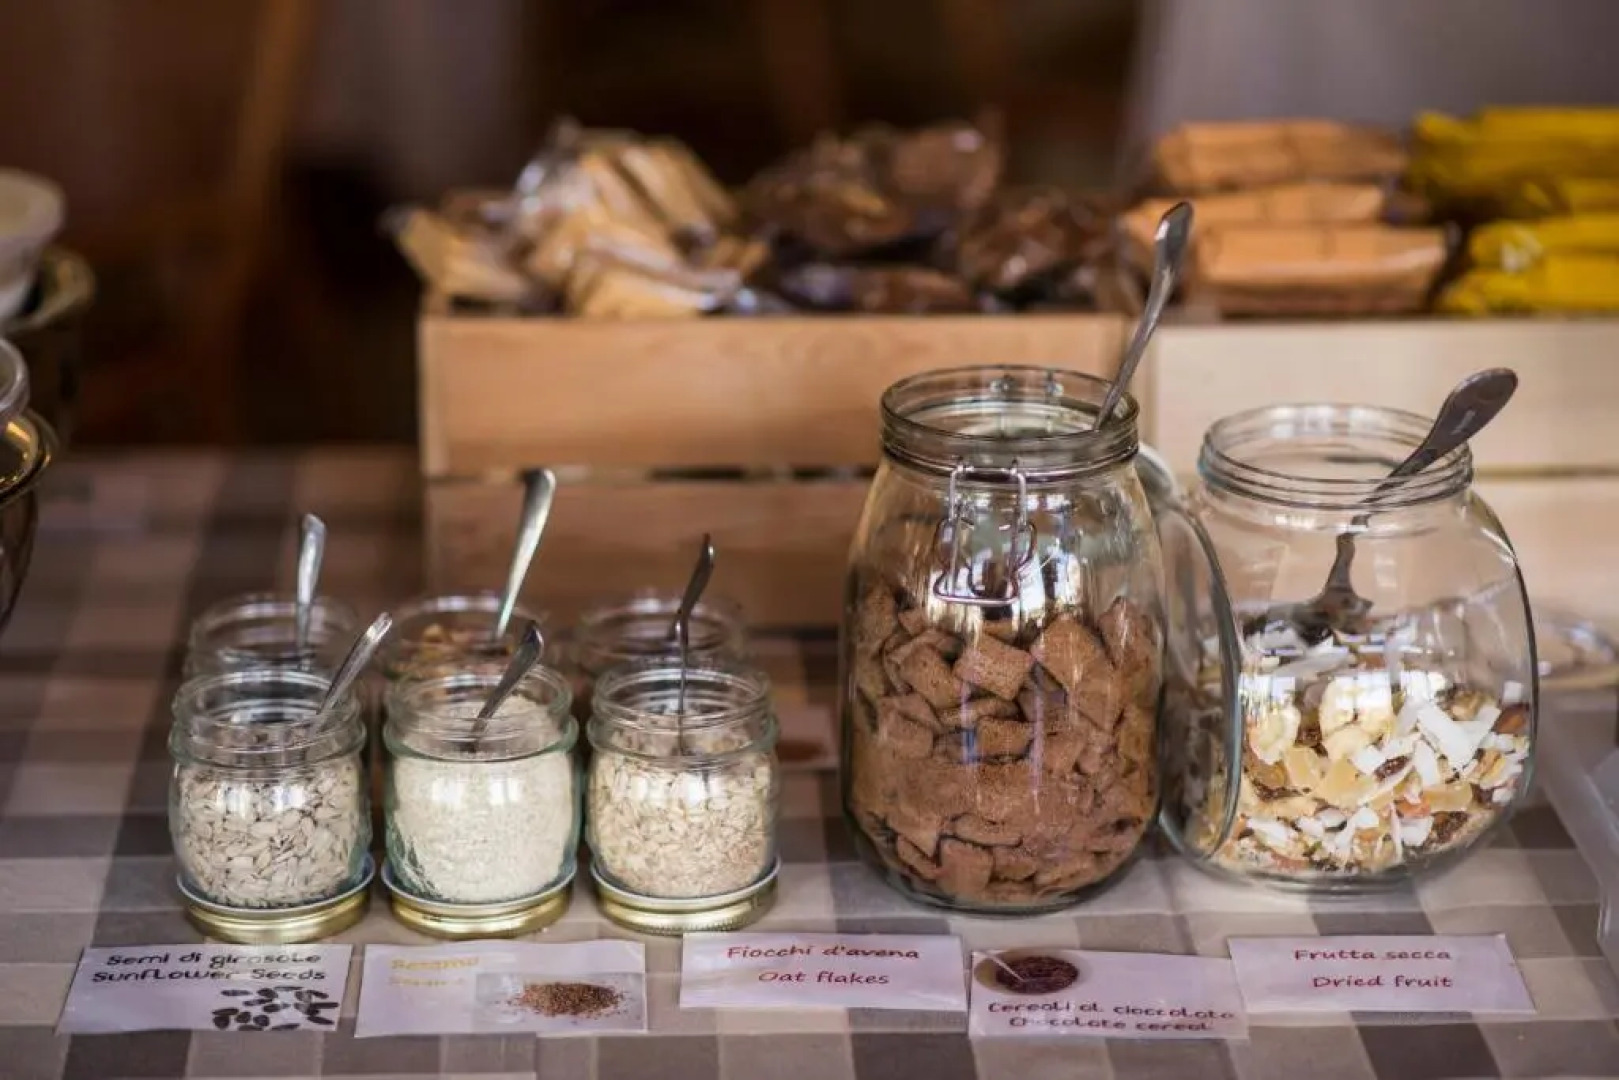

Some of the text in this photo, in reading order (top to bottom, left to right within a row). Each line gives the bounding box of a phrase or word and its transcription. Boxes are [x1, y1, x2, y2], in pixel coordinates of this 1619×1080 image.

[107, 952, 170, 965] Semi
[178, 951, 202, 963] di
[727, 944, 920, 959] Fiocchi d'avena
[1294, 949, 1451, 960] Frutta secca
[758, 970, 890, 984] Oat flakes
[1312, 975, 1454, 987] Dried fruit
